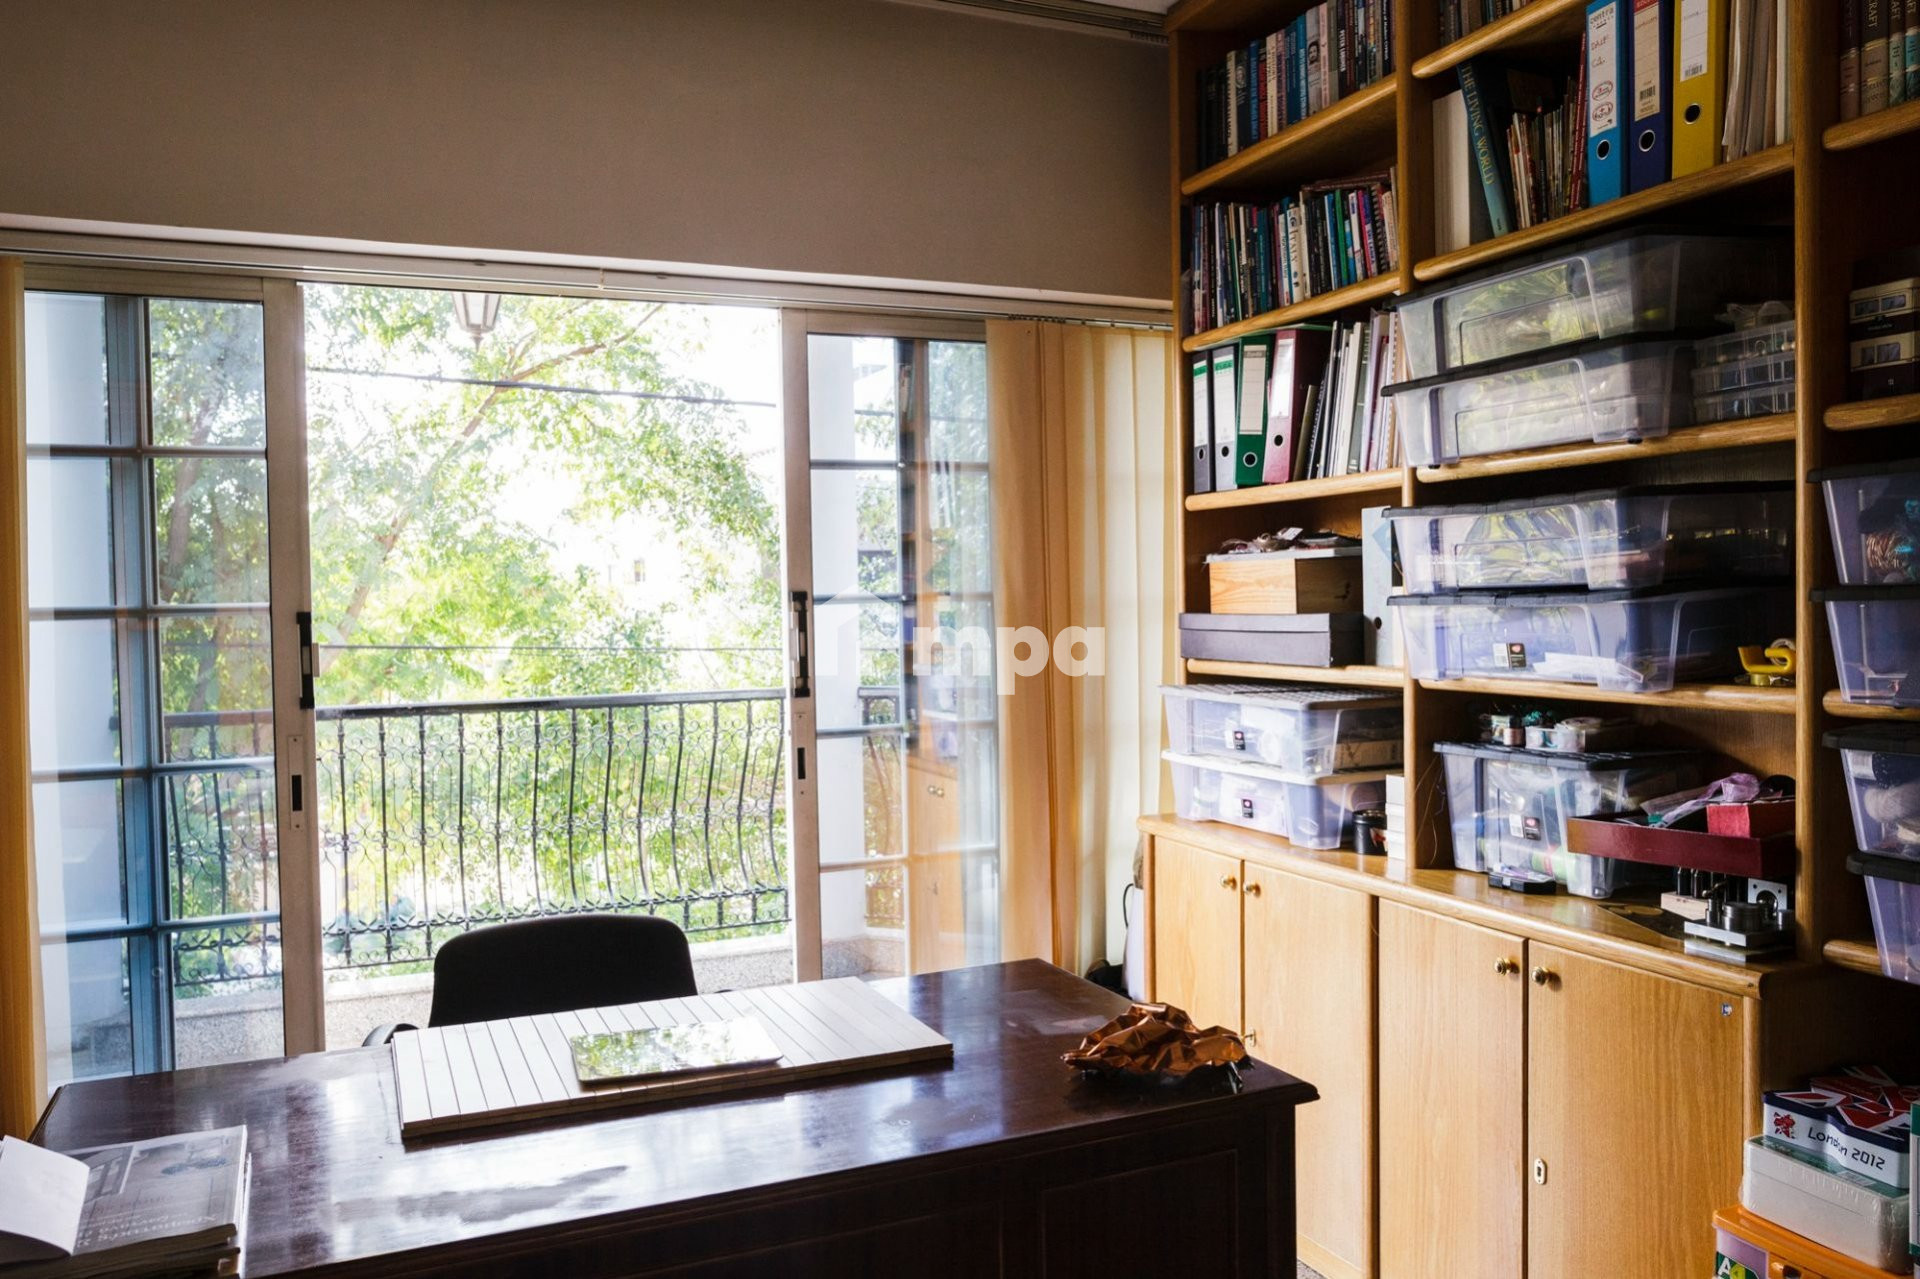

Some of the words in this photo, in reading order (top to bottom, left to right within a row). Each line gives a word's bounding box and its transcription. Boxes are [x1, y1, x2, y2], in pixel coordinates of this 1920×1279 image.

[1461, 64, 1476, 90] THE
[1466, 92, 1485, 136] LIVING
[1476, 136, 1495, 185] WORLD
[1808, 1127, 1848, 1156] London
[1851, 1148, 1886, 1170] 2012
